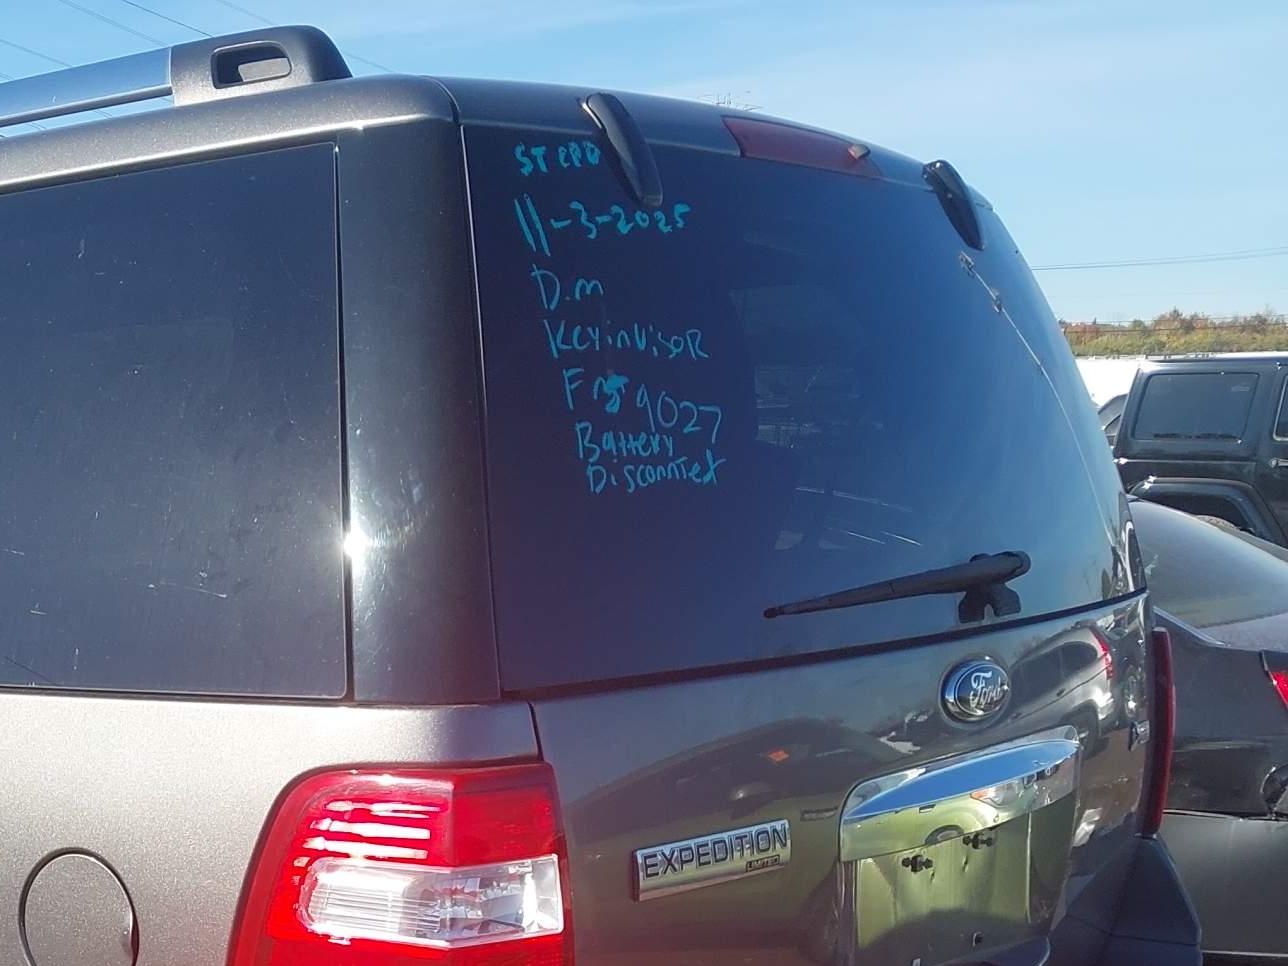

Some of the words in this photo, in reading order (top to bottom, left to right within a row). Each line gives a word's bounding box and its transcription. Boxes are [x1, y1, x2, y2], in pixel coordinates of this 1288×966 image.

[514, 142, 548, 176] ST
[513, 192, 691, 257] 11-3-2025
[636, 383, 723, 445] 9027
[968, 669, 1007, 708] Ford
[642, 822, 789, 880] EXPEDITION
